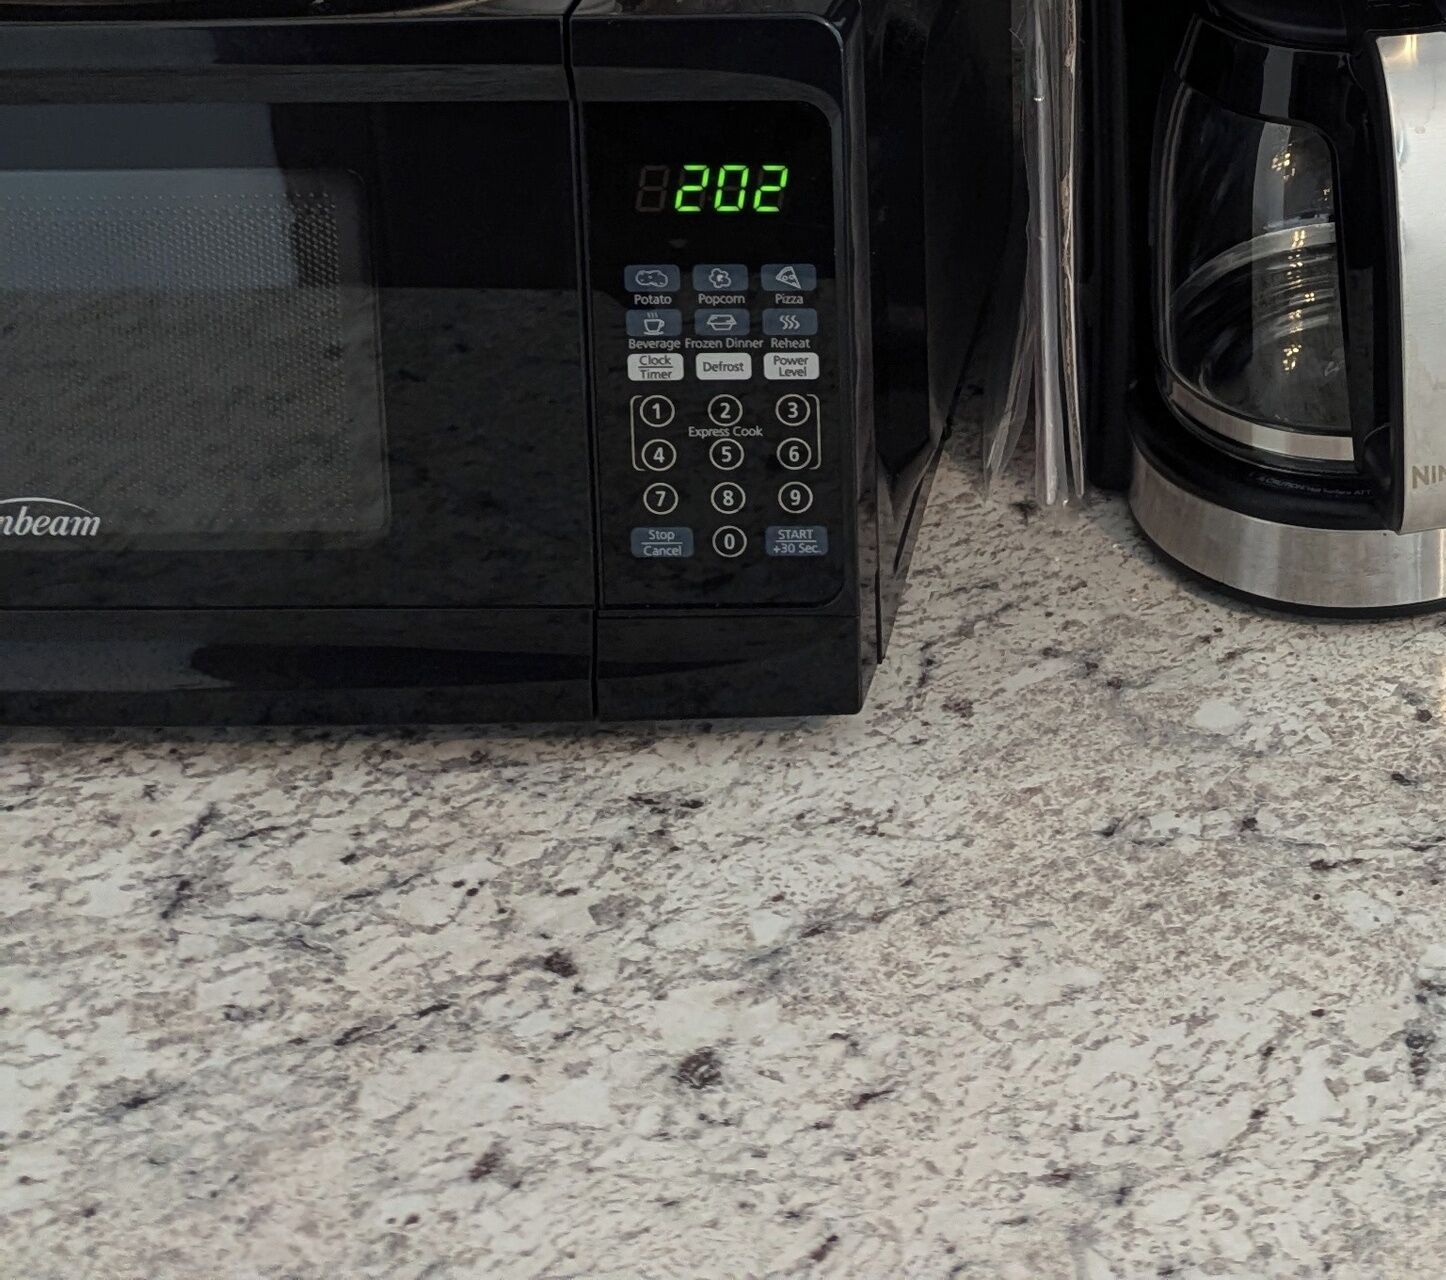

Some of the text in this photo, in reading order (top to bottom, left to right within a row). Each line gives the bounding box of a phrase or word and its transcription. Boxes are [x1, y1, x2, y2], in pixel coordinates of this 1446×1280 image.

[674, 164, 789, 212] 202
[634, 294, 672, 305] Potato
[698, 294, 746, 308] Popcorn
[775, 294, 804, 305] Pizza
[629, 338, 681, 352] Beverage
[685, 338, 764, 349] Frozen Dinner
[771, 338, 811, 349] Reheat
[639, 355, 671, 366] Clock
[773, 355, 808, 365] Power
[703, 361, 744, 372] Defrost
[779, 367, 807, 377] Level
[640, 369, 672, 379] Timer
[652, 402, 799, 420] 1 2 3
[688, 426, 764, 439] Express Cook
[653, 446, 800, 463] 4 5 6
[655, 489, 801, 507] 7 8 9
[0, 505, 101, 537] nbeam
[648, 530, 675, 542] Stop
[778, 530, 814, 539] START
[724, 534, 735, 550] 0
[643, 546, 682, 556] Cancel
[773, 543, 821, 554] +30 Sec.
